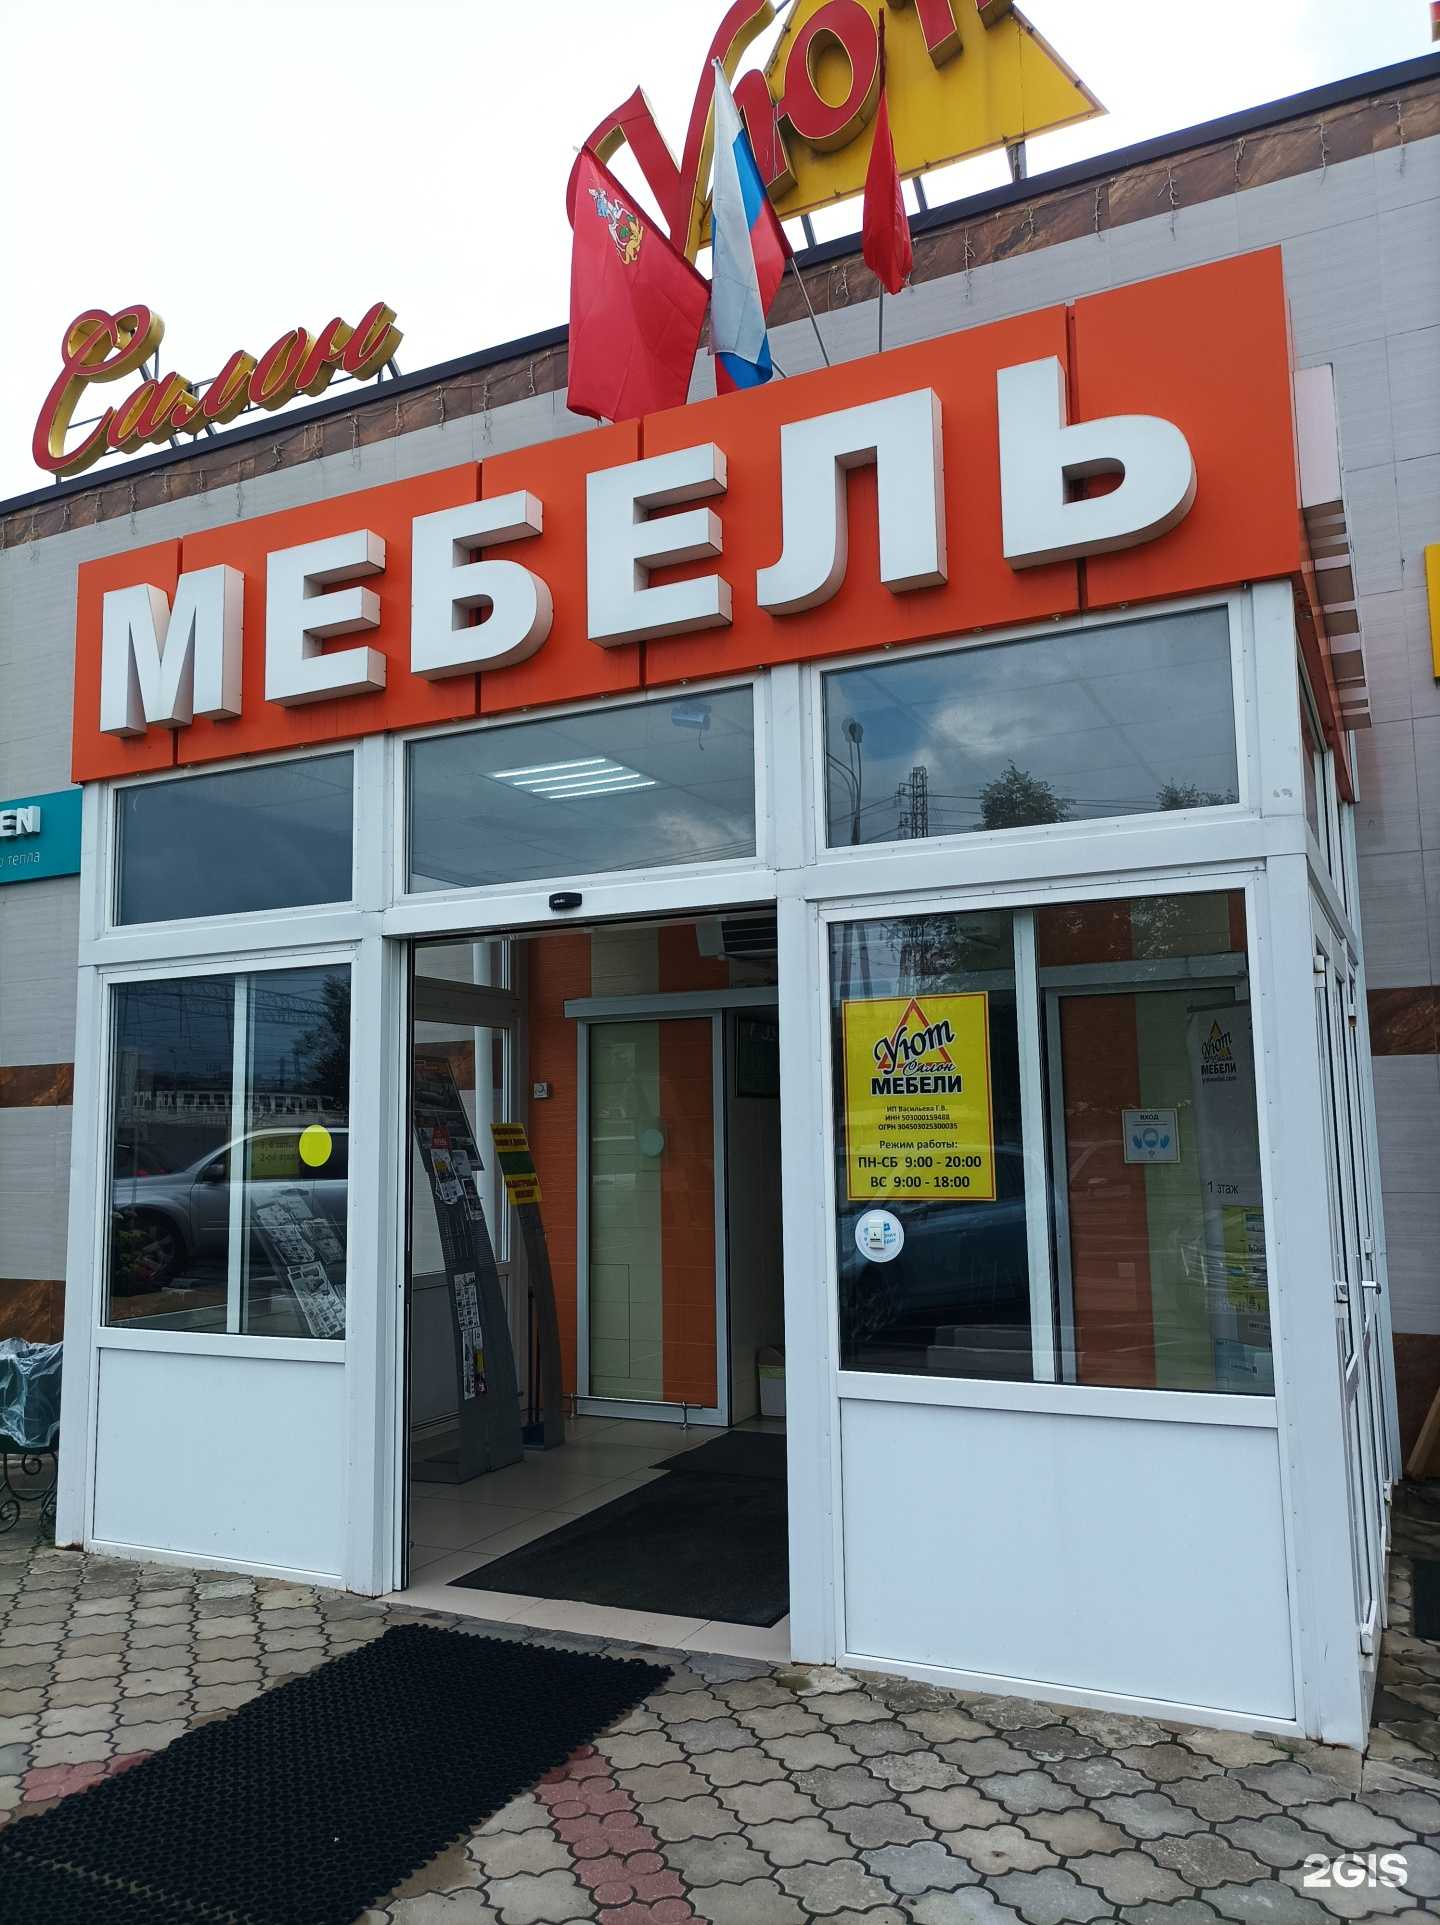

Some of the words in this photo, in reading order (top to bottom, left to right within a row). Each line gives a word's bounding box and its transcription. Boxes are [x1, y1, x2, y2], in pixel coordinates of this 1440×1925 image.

[566, 0, 1013, 264] Ую
[32, 301, 404, 477] Салон
[99, 354, 1196, 738] МЕБЕЛЬ
[8, 851, 40, 866] тепла
[873, 1019, 955, 1075] Уют
[902, 1059, 957, 1077] Салон
[1201, 1062, 1237, 1075] МЕБЕЛИ
[871, 1075, 962, 1095] МЕБЕЛИ
[878, 1123, 896, 1131] ОГРН
[879, 1140, 914, 1149] Режим
[916, 1140, 958, 1151] работы:
[858, 1156, 898, 1168] ПН-СБ
[905, 1156, 933, 1168] 9:00
[945, 1155, 981, 1168] 20:00
[870, 1176, 887, 1188] ВС
[893, 1176, 921, 1188] 9:00
[933, 1176, 970, 1188] 18:00
[1207, 1181, 1214, 1194] 1
[1217, 1182, 1239, 1196] этаж
